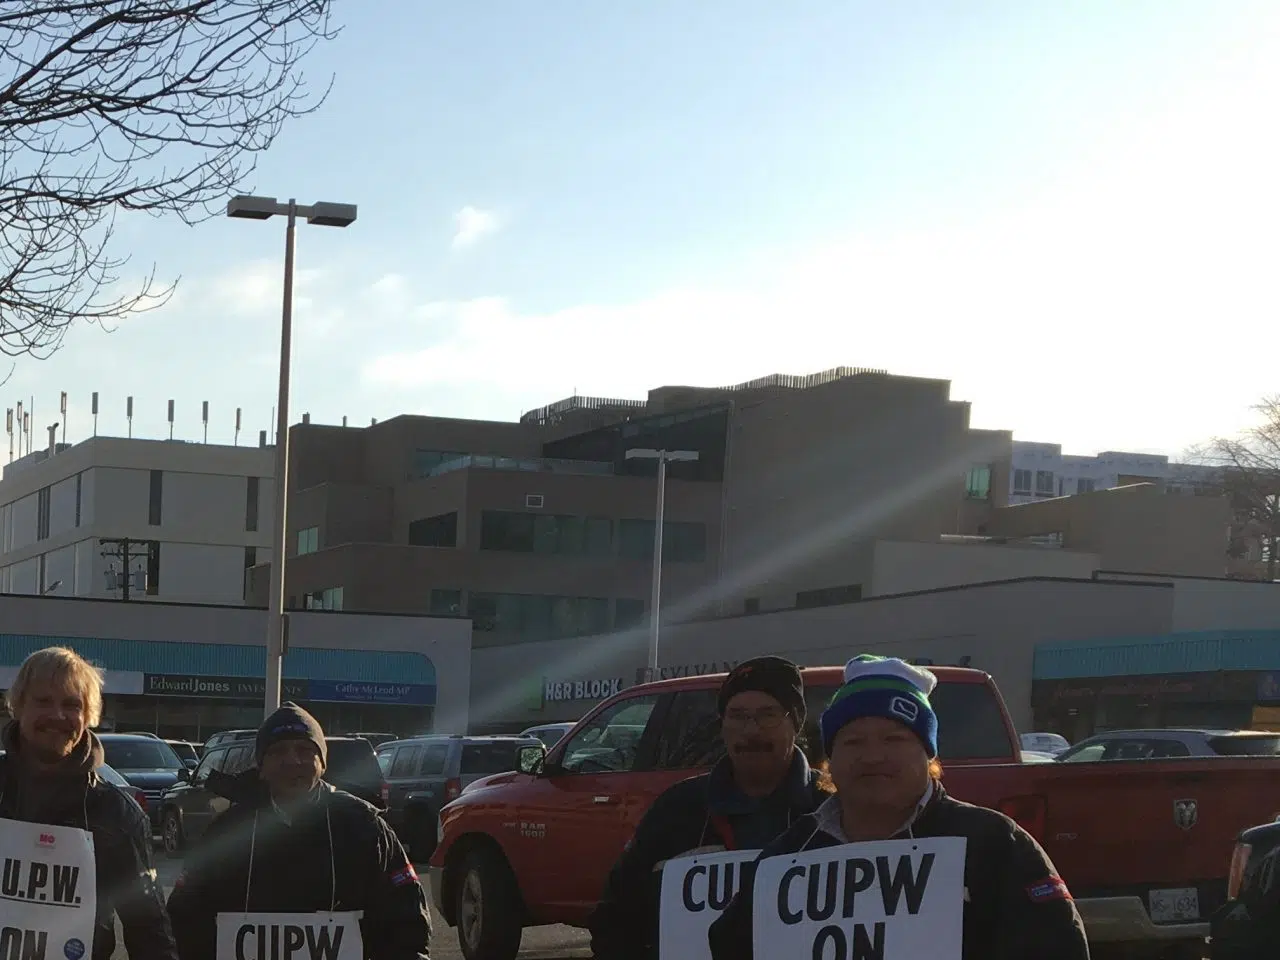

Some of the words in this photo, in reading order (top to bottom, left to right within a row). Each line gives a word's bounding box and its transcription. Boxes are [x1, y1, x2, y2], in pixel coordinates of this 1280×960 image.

[546, 682, 572, 700] H&R
[575, 679, 622, 699] BLOCK
[683, 861, 753, 912] CU
[777, 853, 935, 925] CUPW
